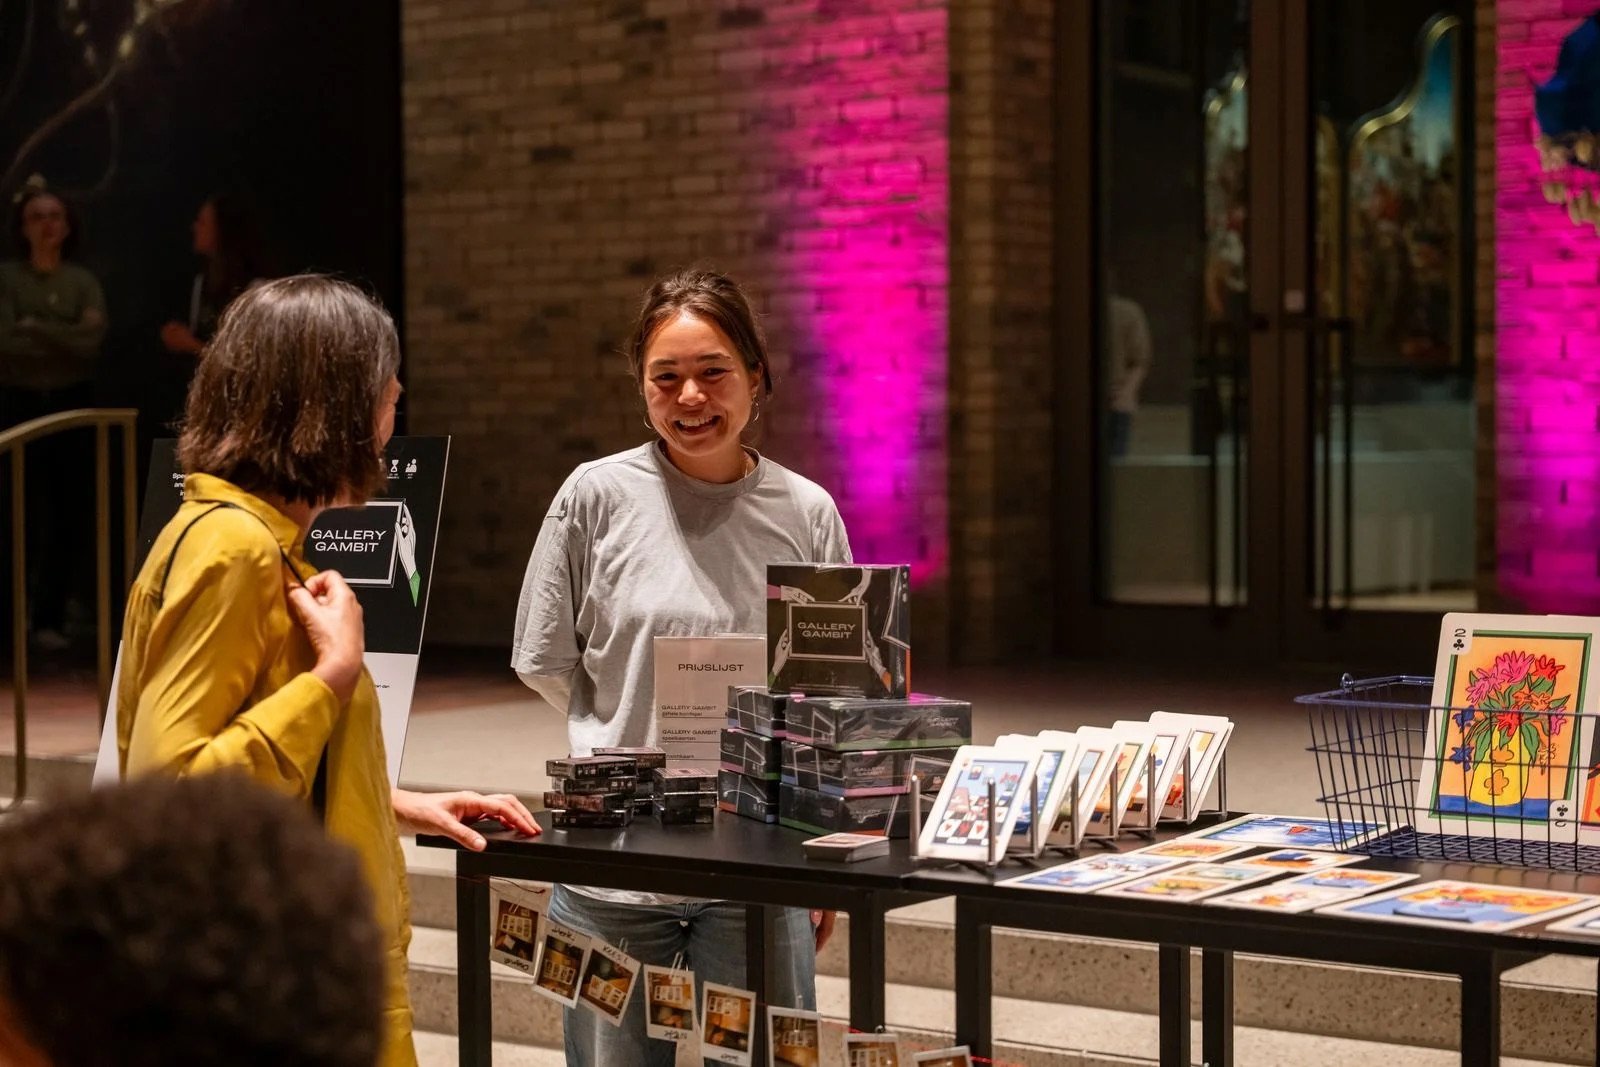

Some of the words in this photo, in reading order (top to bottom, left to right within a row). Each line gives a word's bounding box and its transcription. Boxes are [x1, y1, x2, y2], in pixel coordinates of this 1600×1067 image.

[310, 529, 387, 540] GALLERY
[315, 541, 379, 552] GAMBIT
[797, 622, 856, 631] GALLERY
[802, 630, 852, 639] GAMBIT
[1454, 629, 1467, 638] 2
[678, 663, 744, 672] PRIJSLIJST
